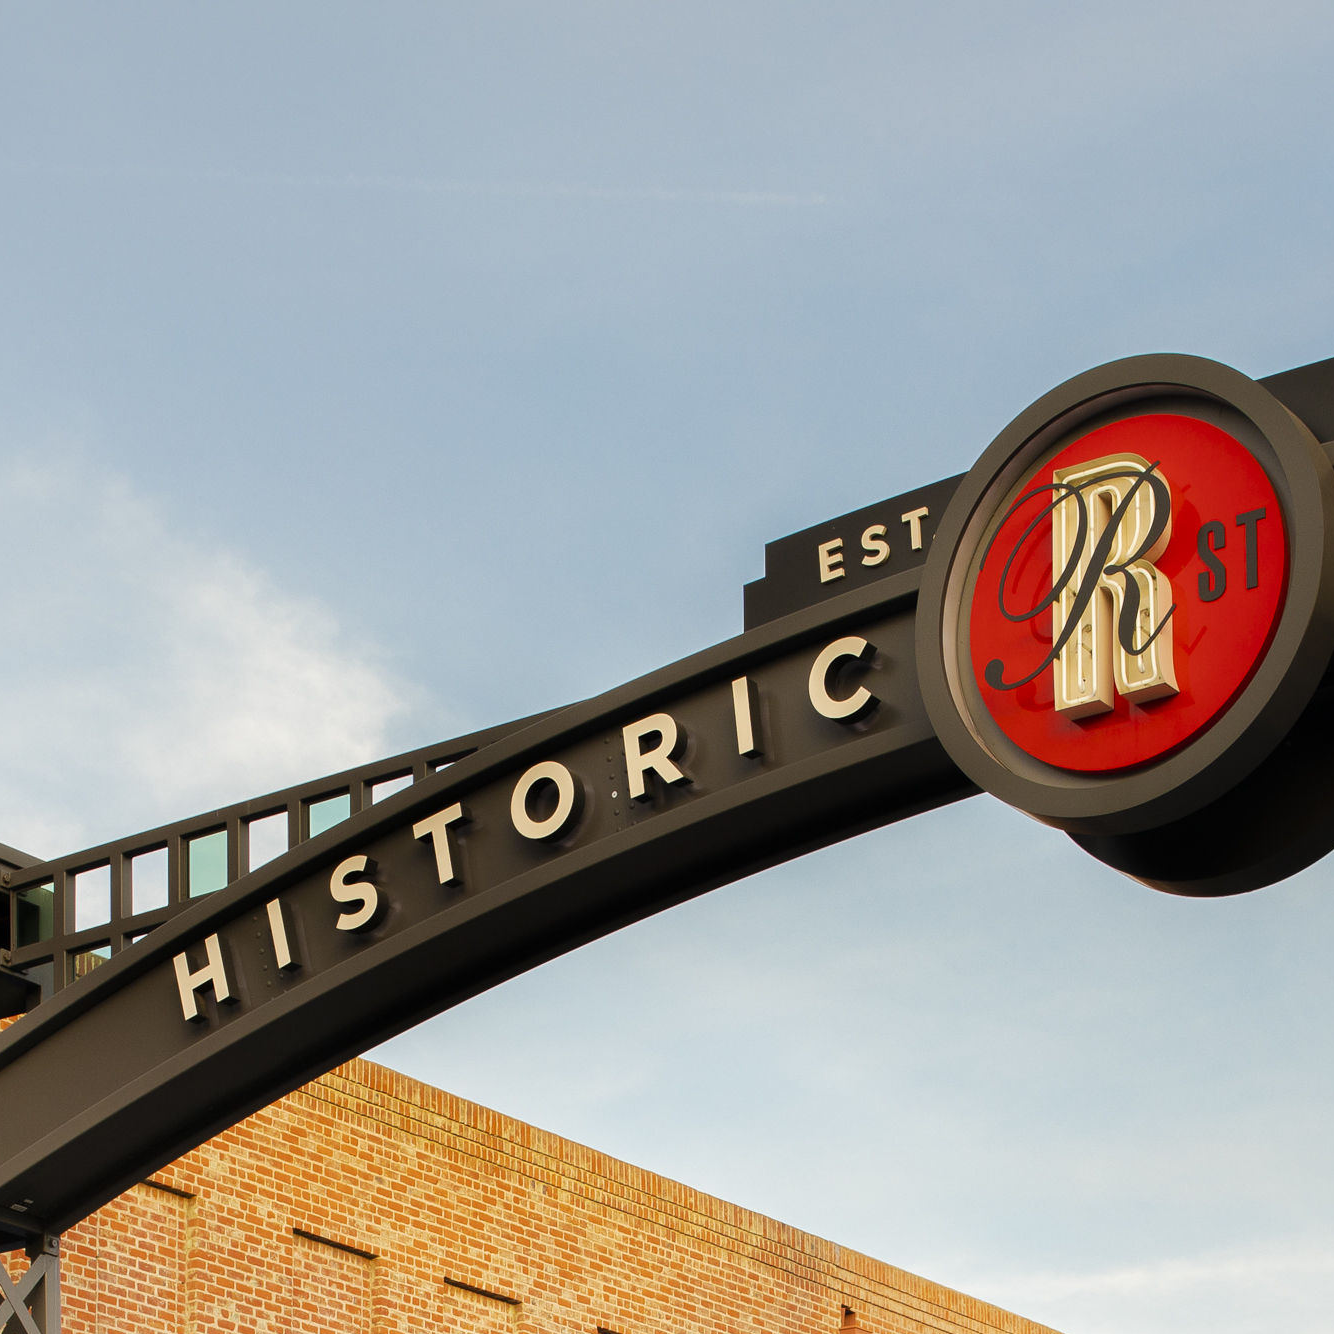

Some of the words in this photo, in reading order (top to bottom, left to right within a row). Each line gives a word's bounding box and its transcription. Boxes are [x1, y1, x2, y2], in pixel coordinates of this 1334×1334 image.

[818, 506, 933, 583] EST
[979, 452, 1180, 720] R
[1197, 507, 1267, 602] ST
[172, 636, 875, 1023] HISTORIC
